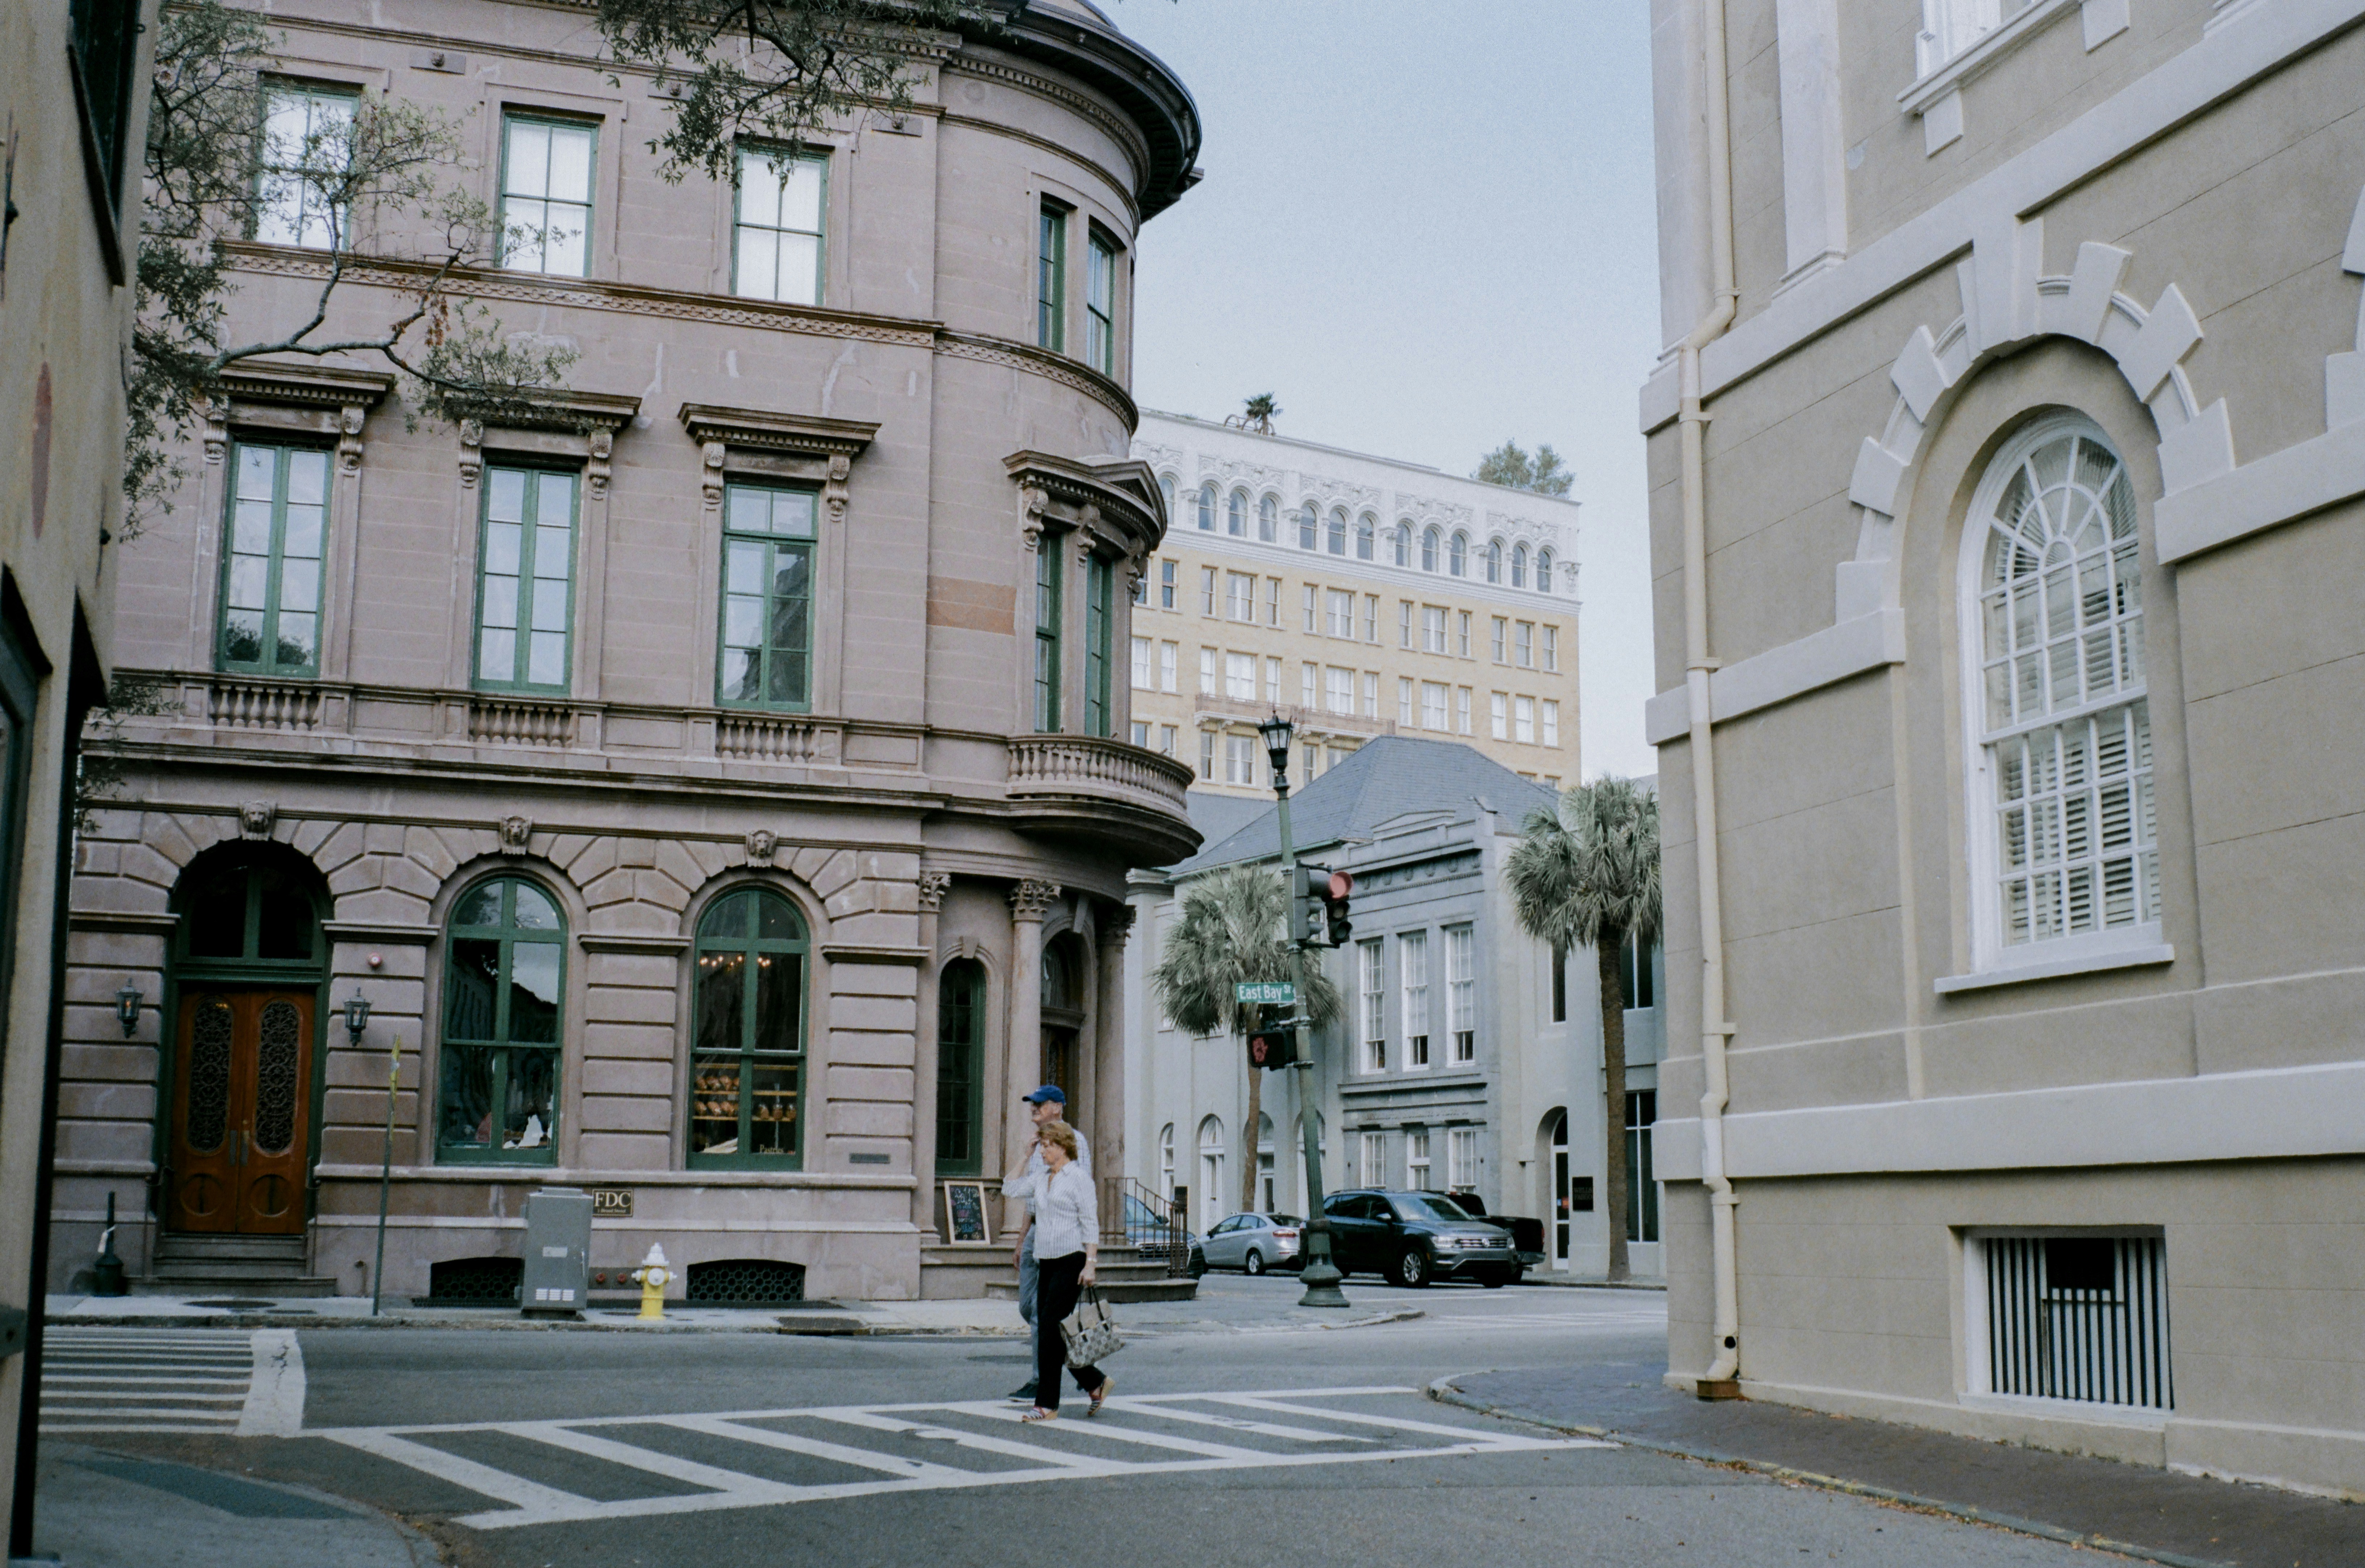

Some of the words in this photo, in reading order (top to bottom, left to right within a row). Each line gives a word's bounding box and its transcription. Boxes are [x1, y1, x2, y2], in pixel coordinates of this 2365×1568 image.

[1239, 985, 1262, 1000] East
[1264, 984, 1282, 1001] Bay
[1283, 984, 1291, 994] St
[594, 1192, 631, 1208] FDC
